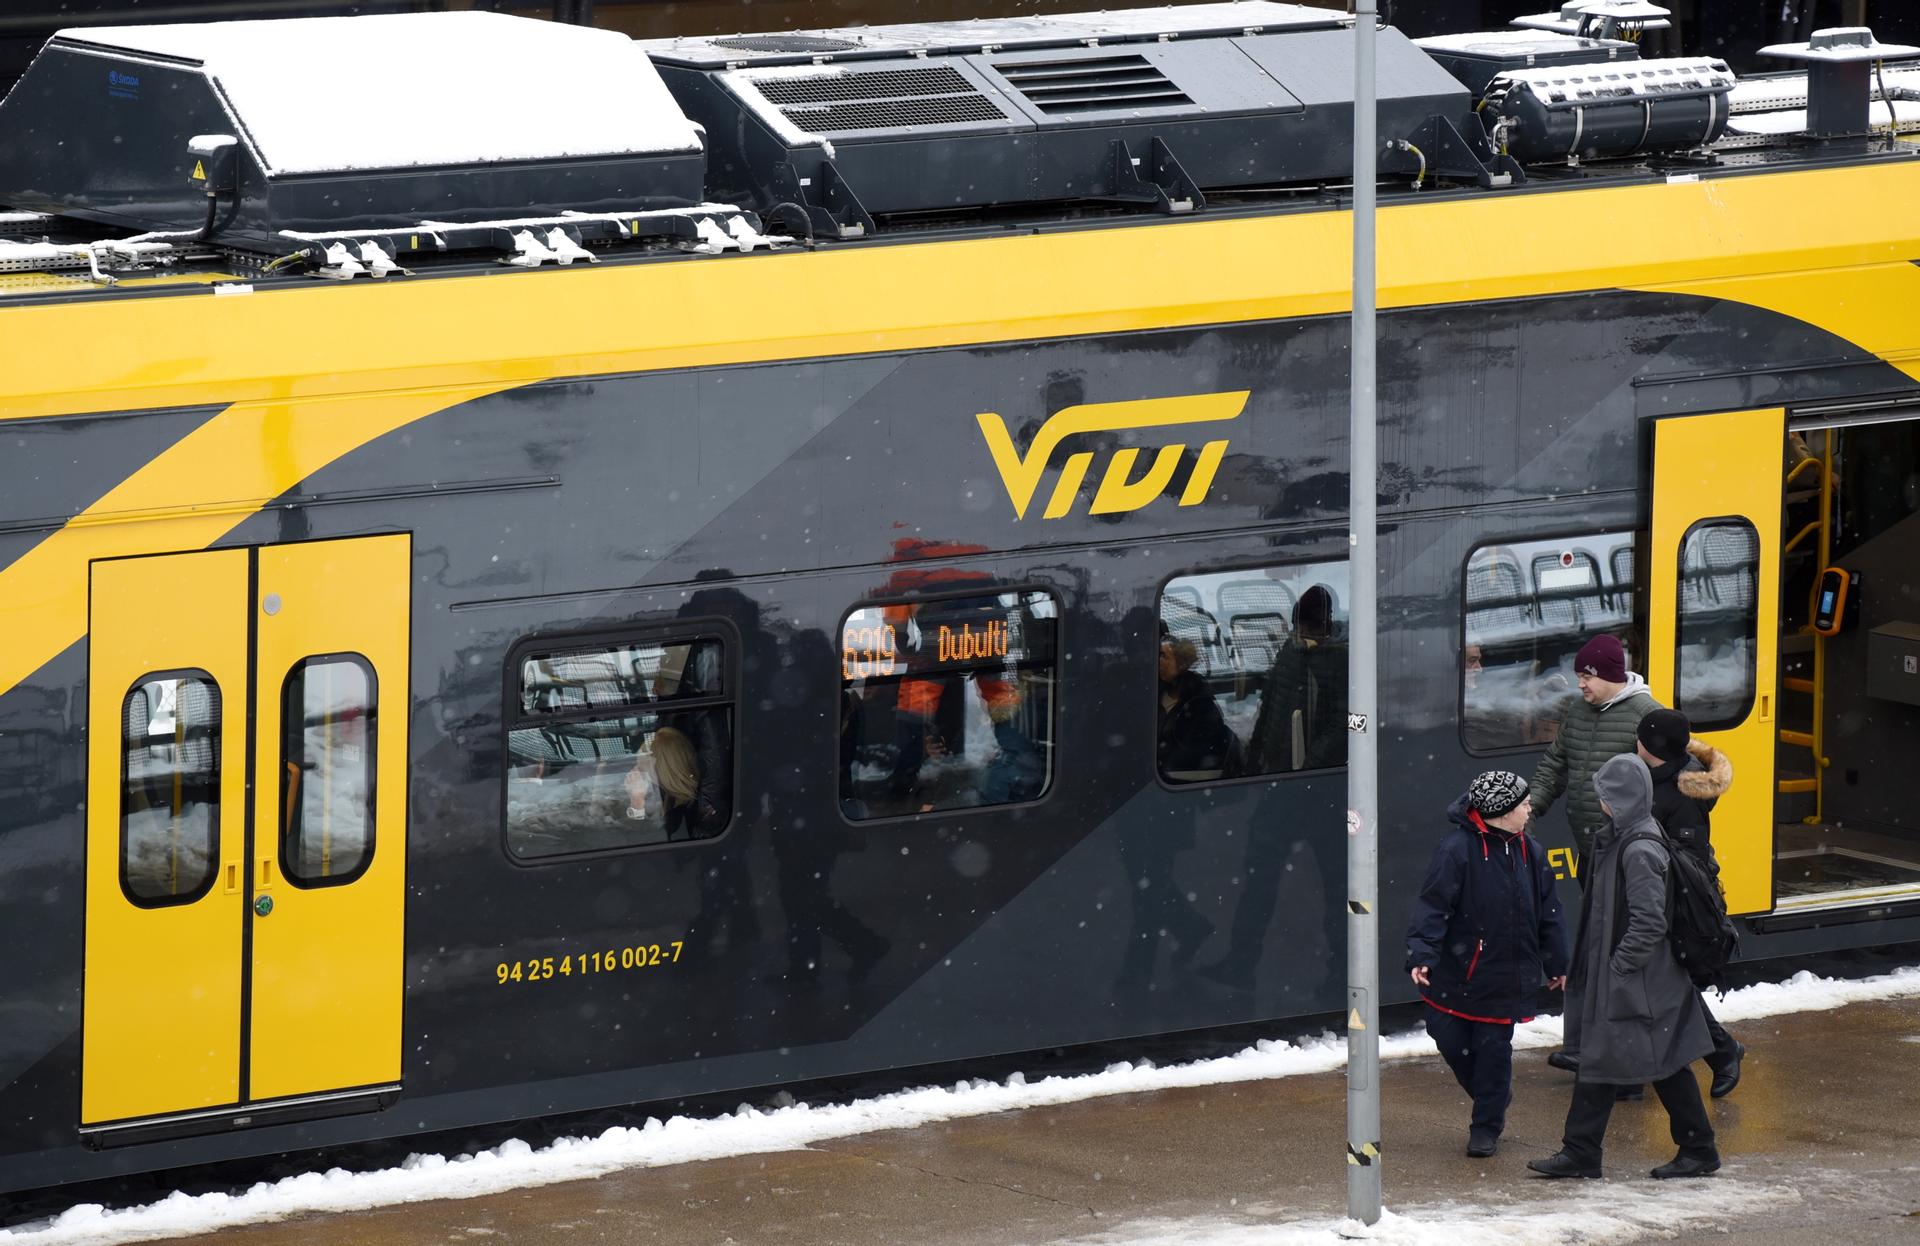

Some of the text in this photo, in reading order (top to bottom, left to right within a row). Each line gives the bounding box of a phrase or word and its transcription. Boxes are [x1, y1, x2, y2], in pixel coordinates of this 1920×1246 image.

[842, 620, 1008, 680] 6319 Dubulti
[496, 941, 683, 984] 94 25 4 116 002-7
